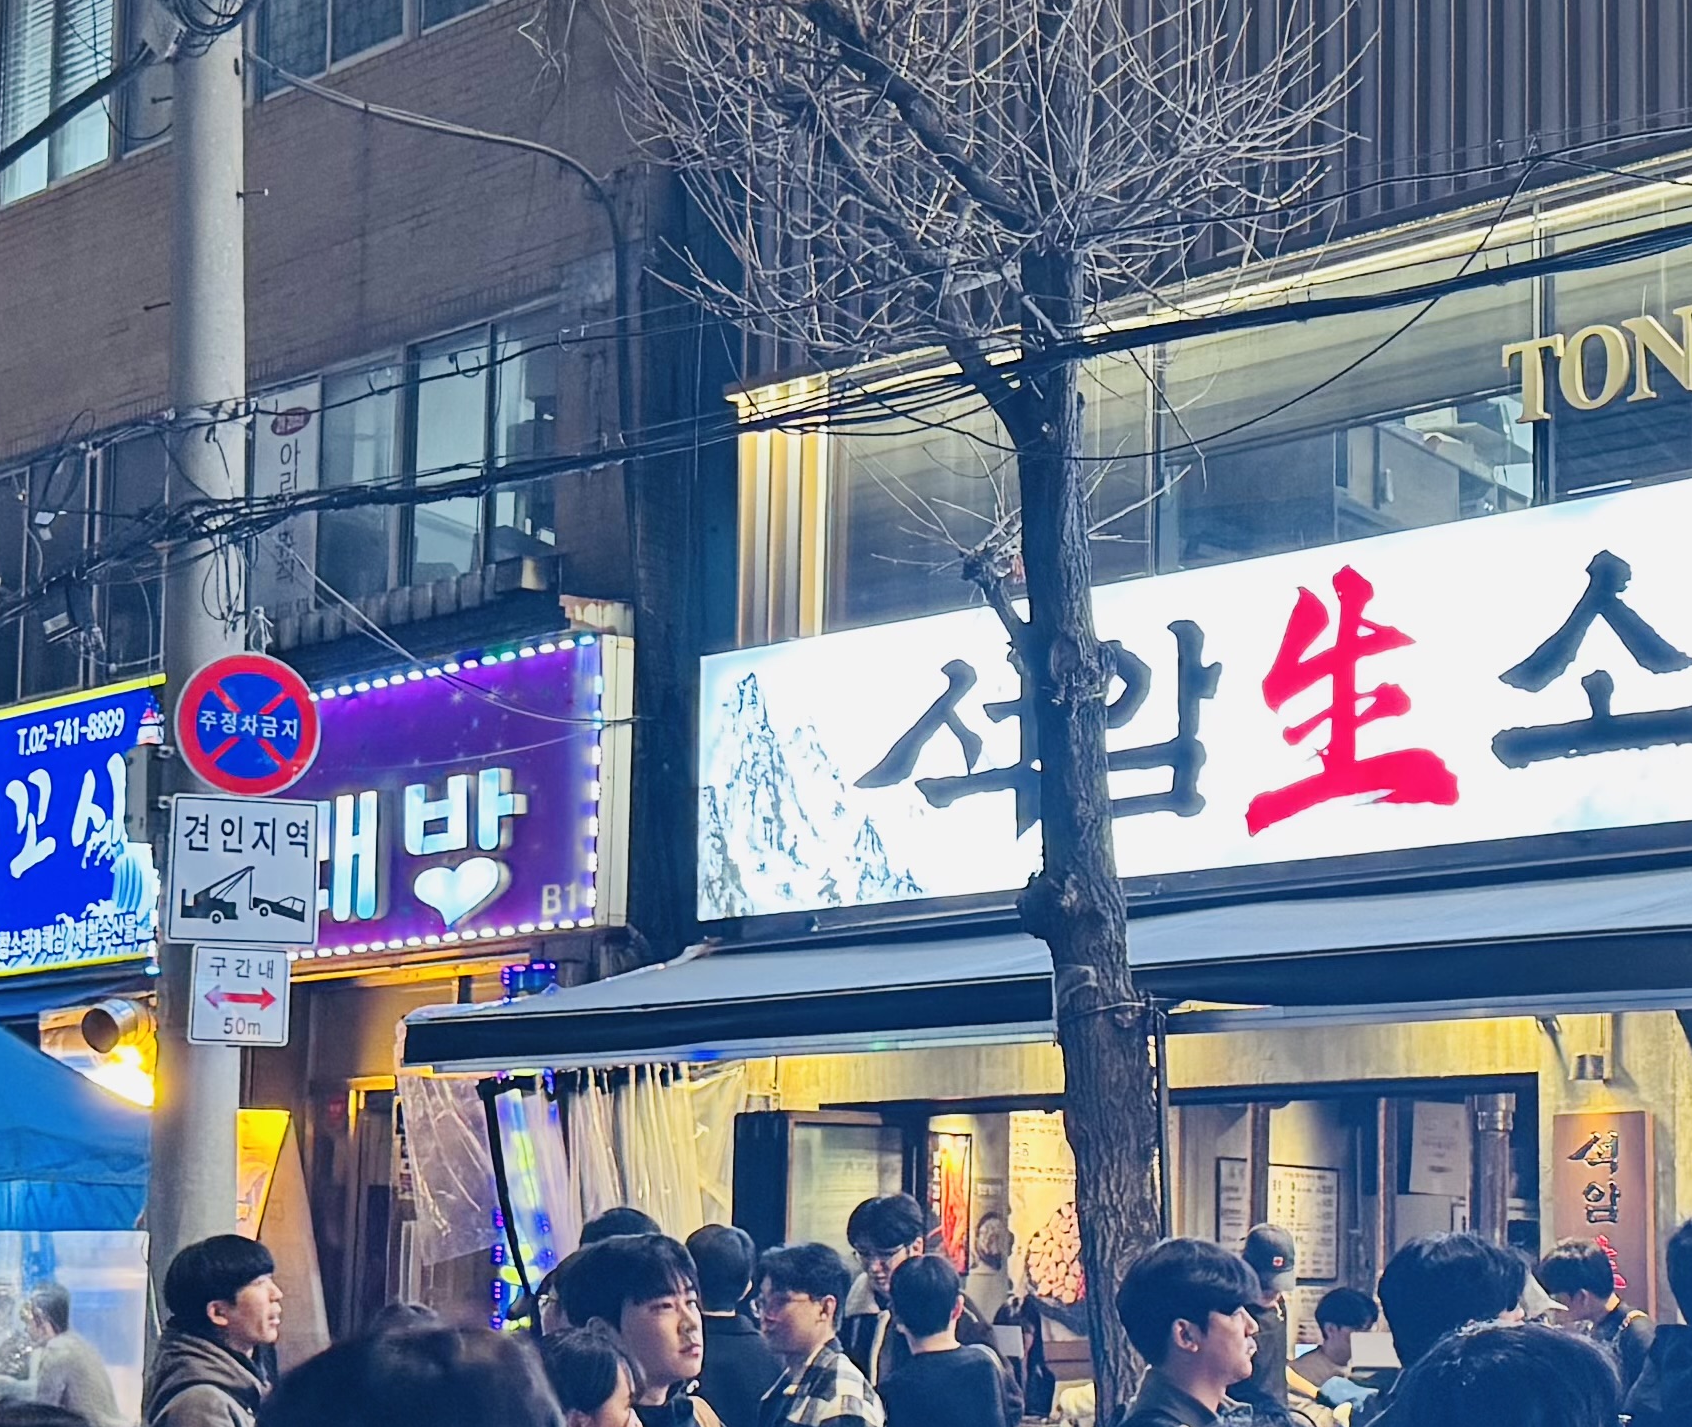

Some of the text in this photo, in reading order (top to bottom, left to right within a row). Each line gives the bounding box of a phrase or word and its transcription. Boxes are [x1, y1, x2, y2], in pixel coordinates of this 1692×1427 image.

[1244, 564, 1459, 837] 生
[17, 707, 126, 756] T.02-741-8899
[198, 709, 299, 741] 주정차금지
[184, 813, 310, 859] 견인지역
[209, 956, 276, 980] 구간내
[223, 1017, 262, 1036] 50m
